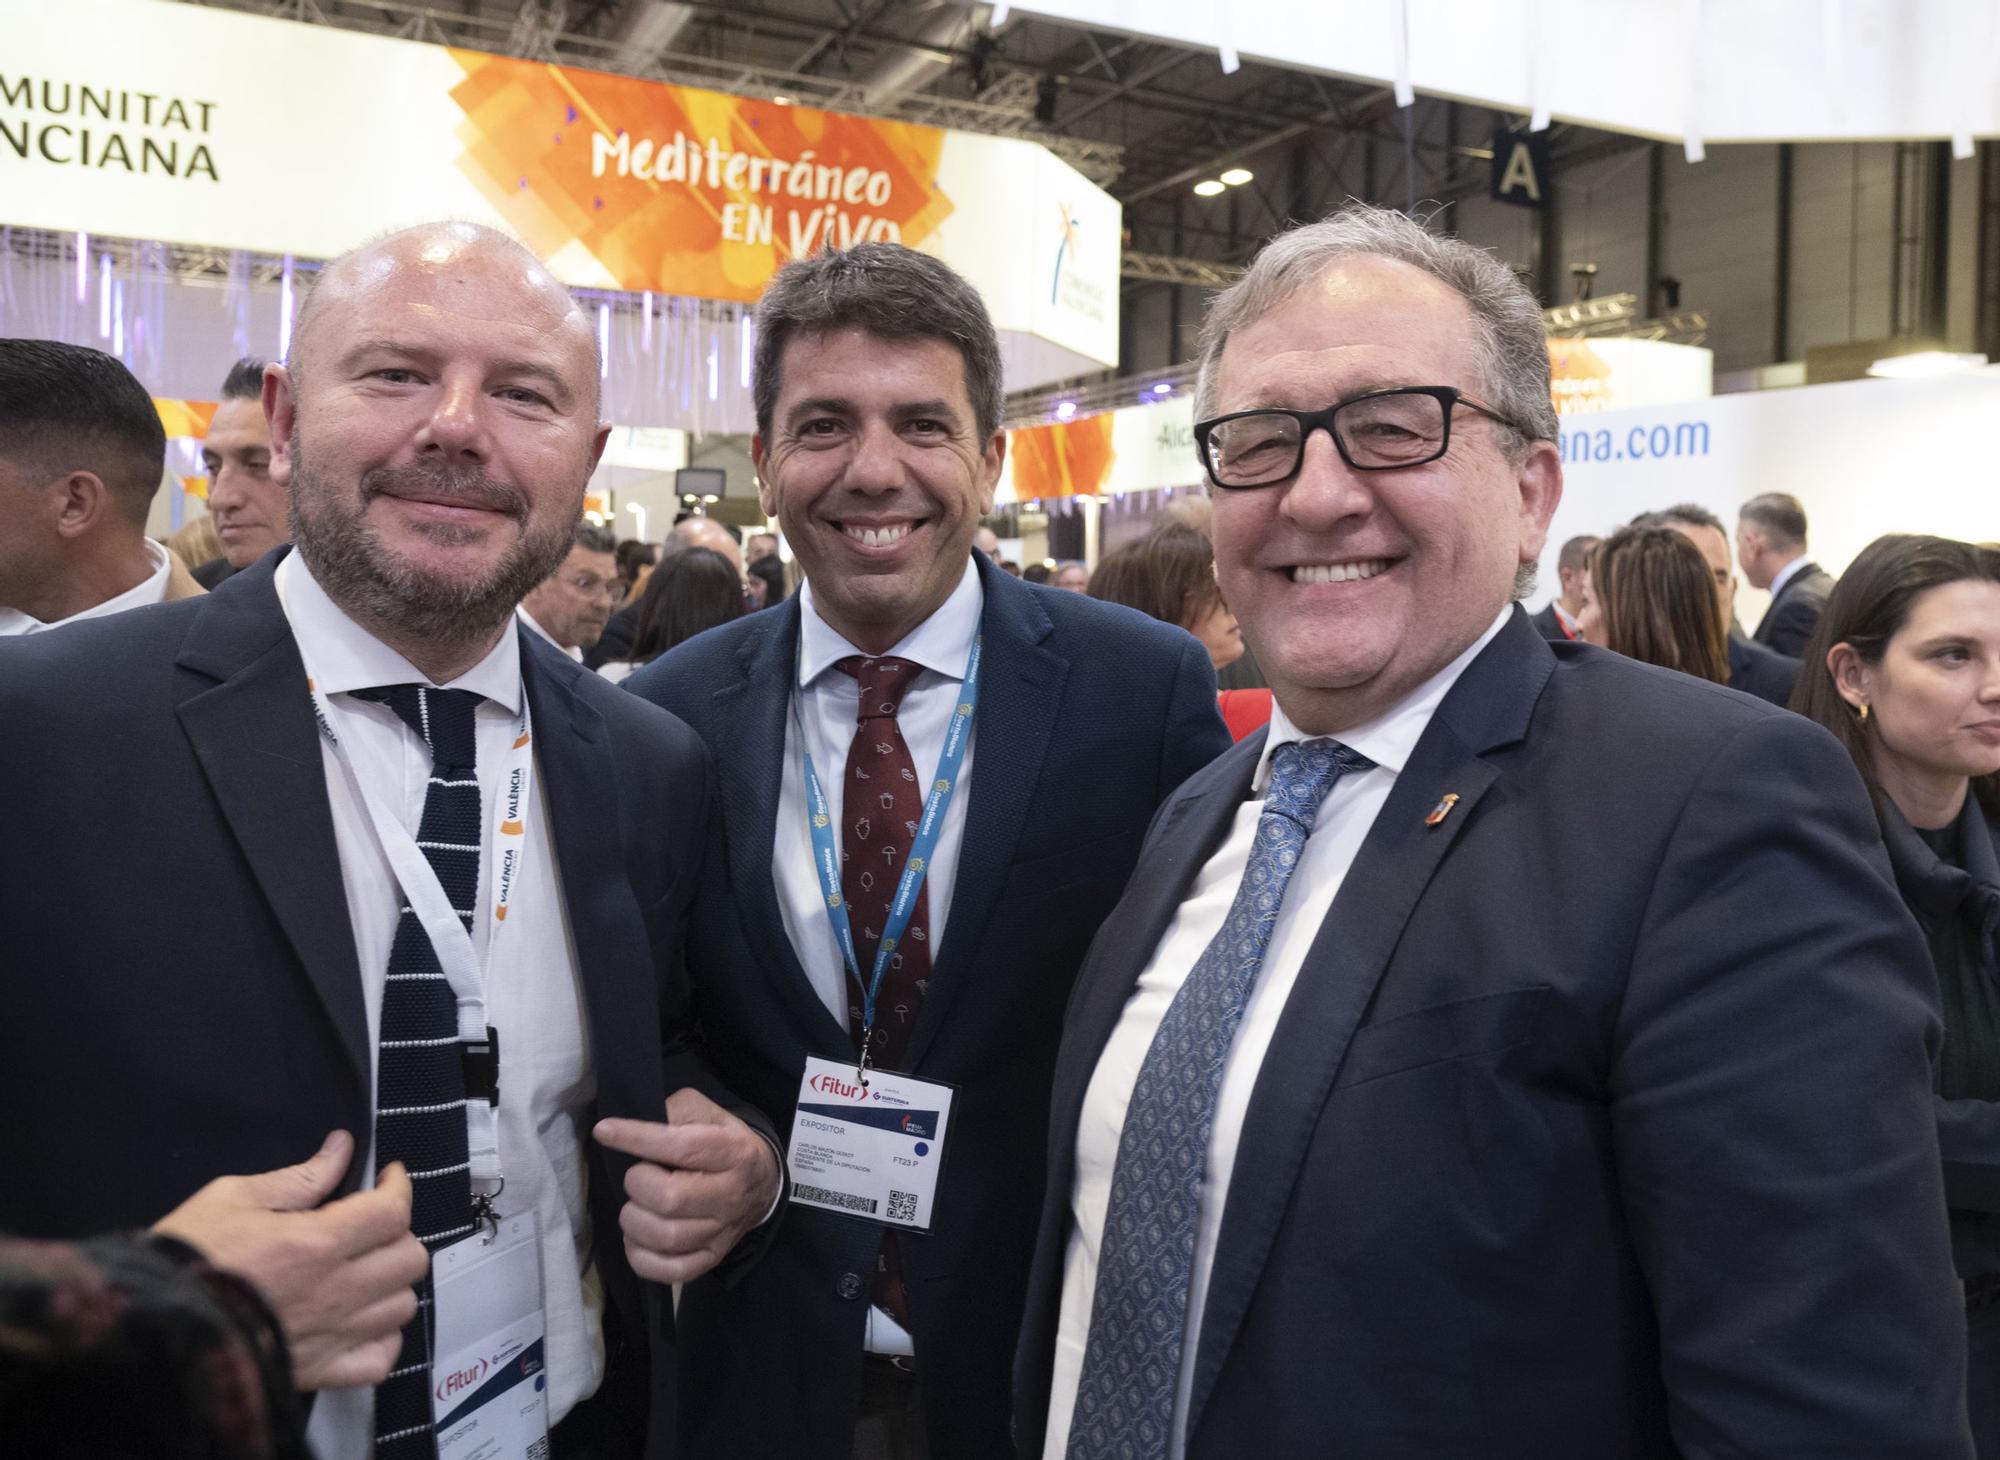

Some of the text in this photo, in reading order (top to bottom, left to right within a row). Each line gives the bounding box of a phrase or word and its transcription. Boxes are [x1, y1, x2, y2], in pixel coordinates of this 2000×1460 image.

[592, 131, 891, 206] Mediterráneo
[1500, 142, 1541, 200] A
[721, 203, 773, 246] EN
[800, 1118, 846, 1136] EXPOSITOR
